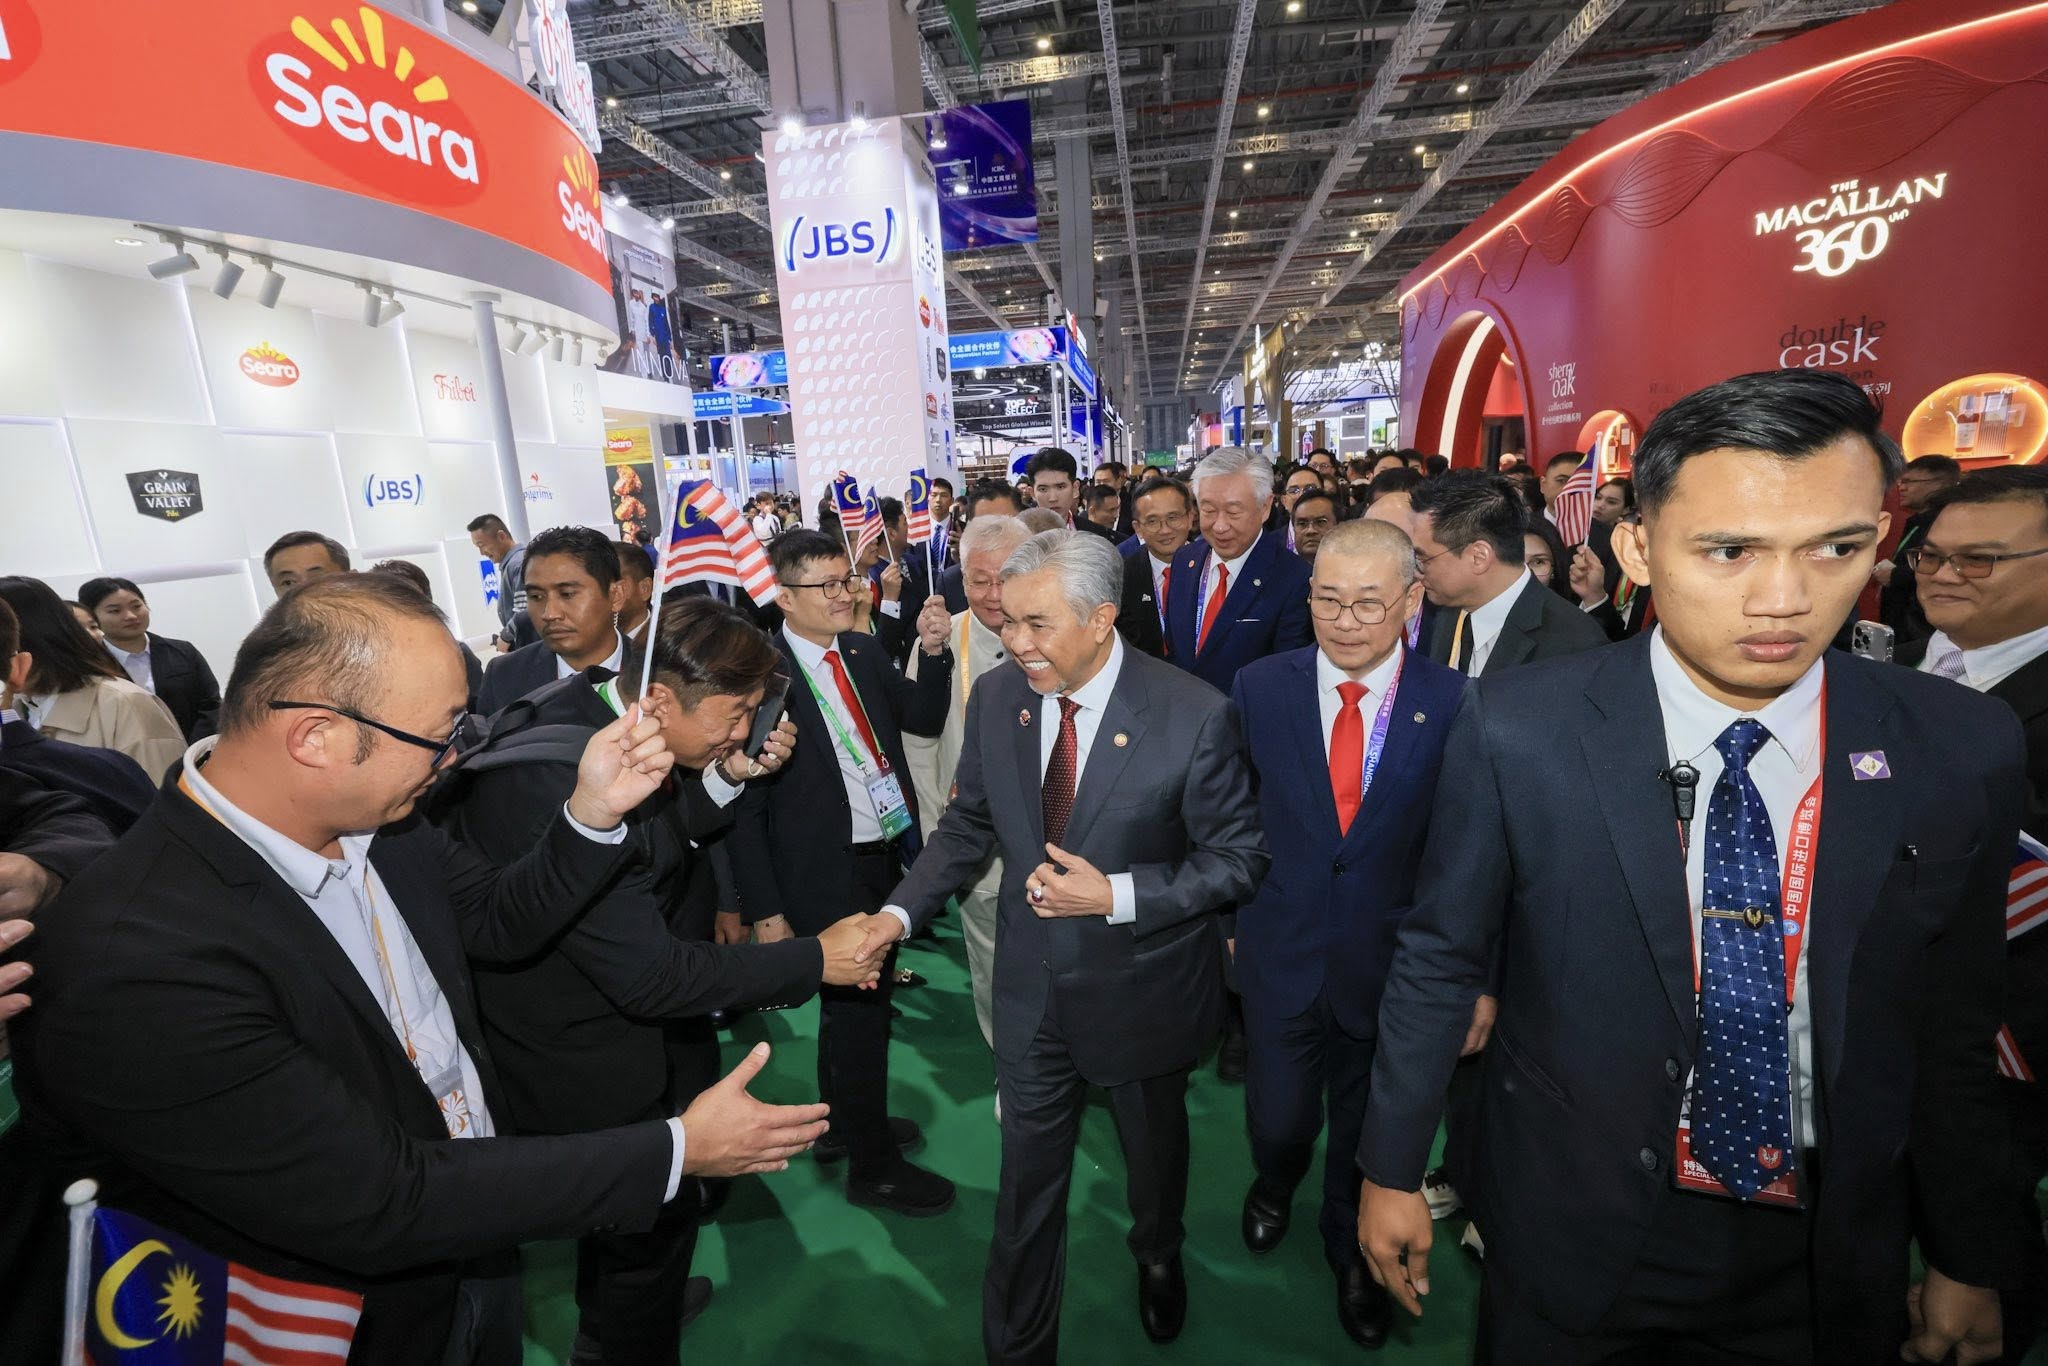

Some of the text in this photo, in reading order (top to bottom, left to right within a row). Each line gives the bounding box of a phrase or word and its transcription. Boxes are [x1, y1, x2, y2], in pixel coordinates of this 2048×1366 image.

[266, 53, 479, 184] Seara
[1830, 179, 1859, 194] THE
[1755, 172, 1947, 236] MACALLAN
[1792, 216, 1889, 277] 360
[1779, 315, 1886, 348] double
[950, 341, 1000, 353] 会全面合作伙伴
[1779, 326, 1880, 369] cask
[242, 357, 297, 379] Seara
[631, 348, 688, 381] INNOVA
[1549, 362, 1576, 381] sherry
[434, 374, 476, 402] Friboi
[1862, 382, 1891, 395] 系列
[1005, 399, 1025, 408] TOP
[1005, 404, 1038, 416] SELECT
[608, 440, 633, 449] Seara
[144, 482, 187, 494] GRAIN
[145, 497, 191, 508] VALLEY
[1363, 751, 1378, 795] SHANGHA
[1784, 796, 1817, 916] 中国国际进口博览会
[1683, 1169, 1711, 1180] SPECIAL
